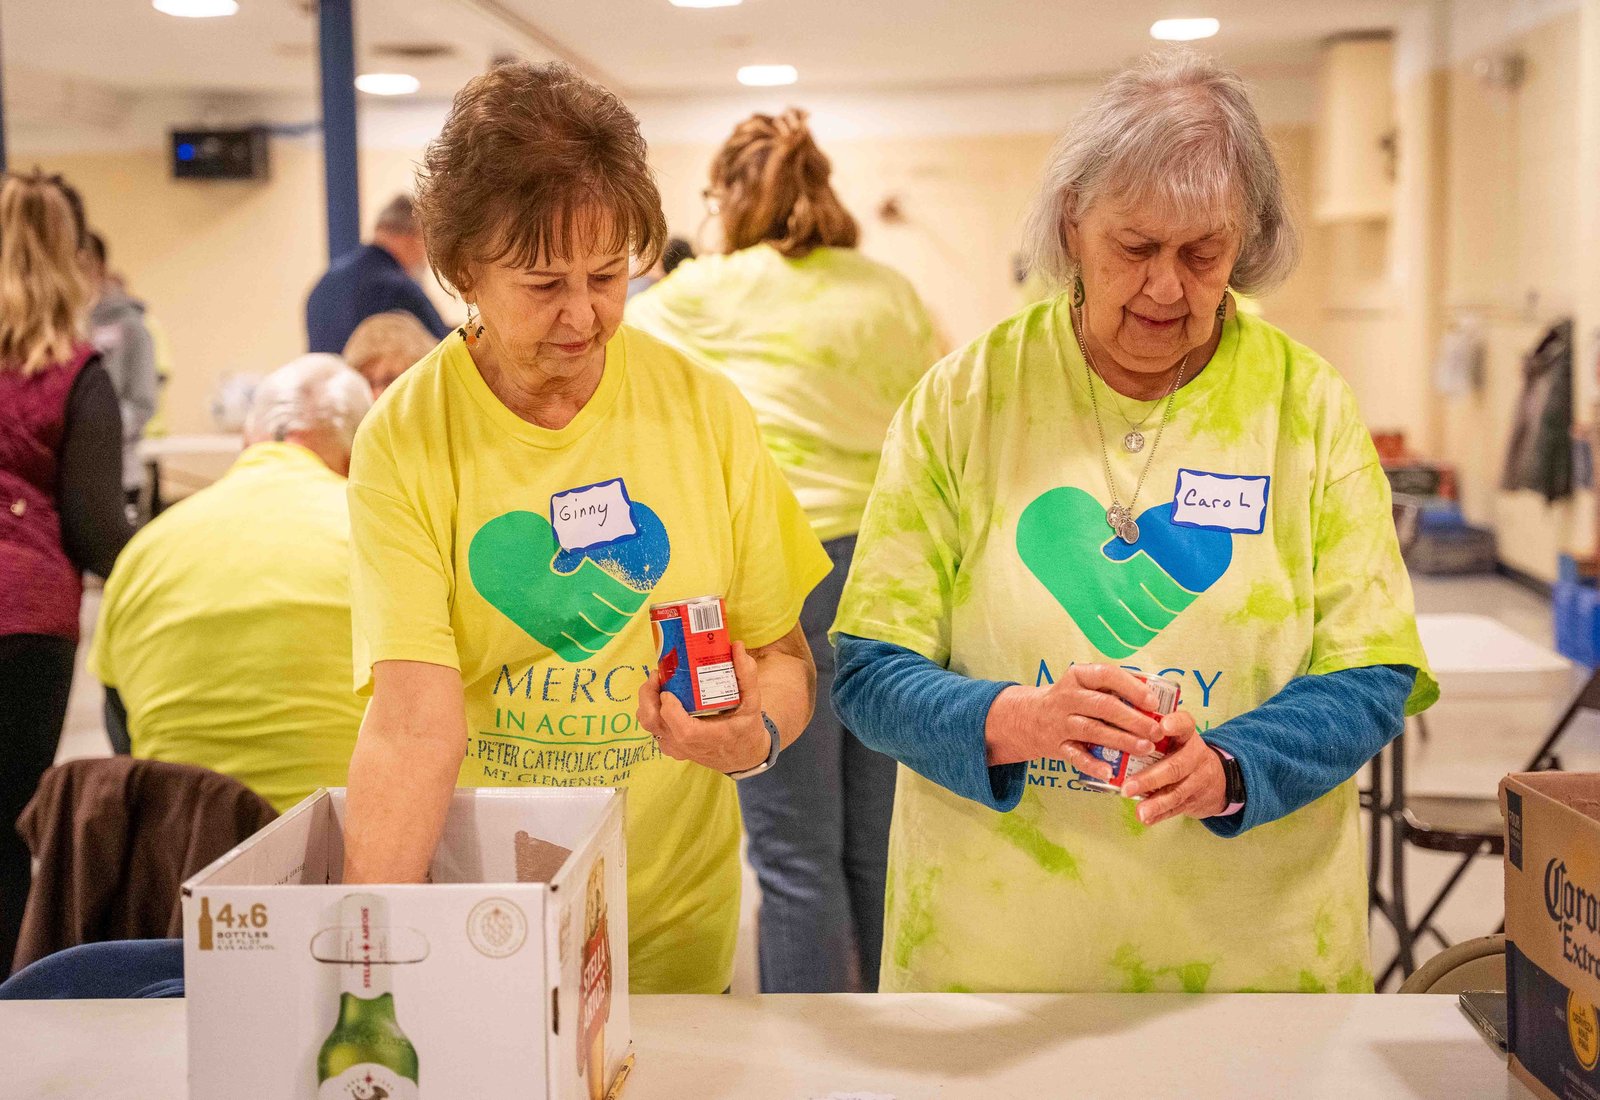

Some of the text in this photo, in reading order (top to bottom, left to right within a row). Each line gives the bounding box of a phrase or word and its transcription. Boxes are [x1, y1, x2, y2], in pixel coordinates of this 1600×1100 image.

[559, 498, 608, 527] Ginny
[492, 664, 650, 703] MERC
[495, 708, 639, 737] IN ACTIO
[478, 740, 520, 768] PETER
[522, 746, 600, 773] CATHOLIC
[603, 738, 662, 771] CHURCH
[483, 765, 512, 782] MT.
[612, 769, 631, 783] MI
[1028, 774, 1062, 788] MT.
[216, 903, 268, 929] 4x6
[216, 931, 269, 939] BOTTLES
